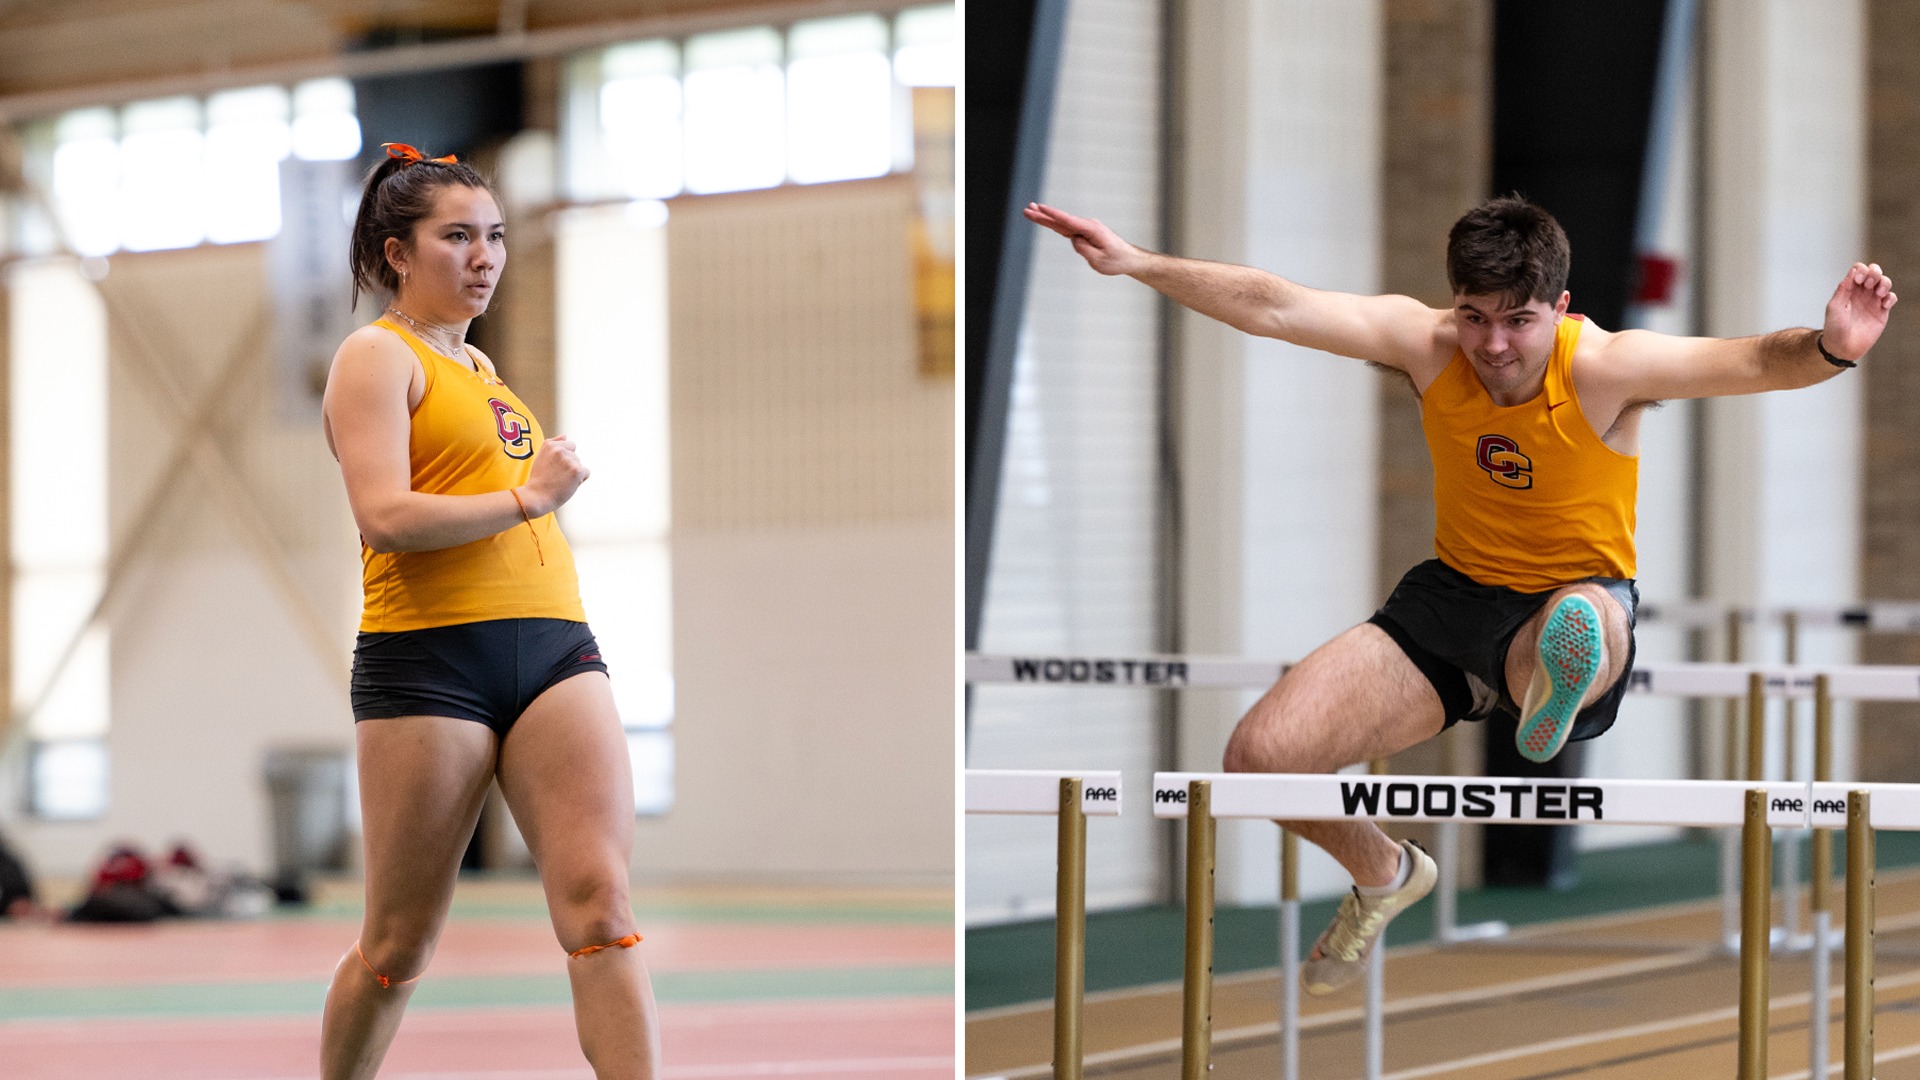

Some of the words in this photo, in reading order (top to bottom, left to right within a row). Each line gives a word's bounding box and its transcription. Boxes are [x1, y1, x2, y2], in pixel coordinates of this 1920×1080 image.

[1476, 434, 1533, 490] CC
[1012, 658, 1189, 684] WOOSTER
[1340, 782, 1604, 820] WOOSTER
